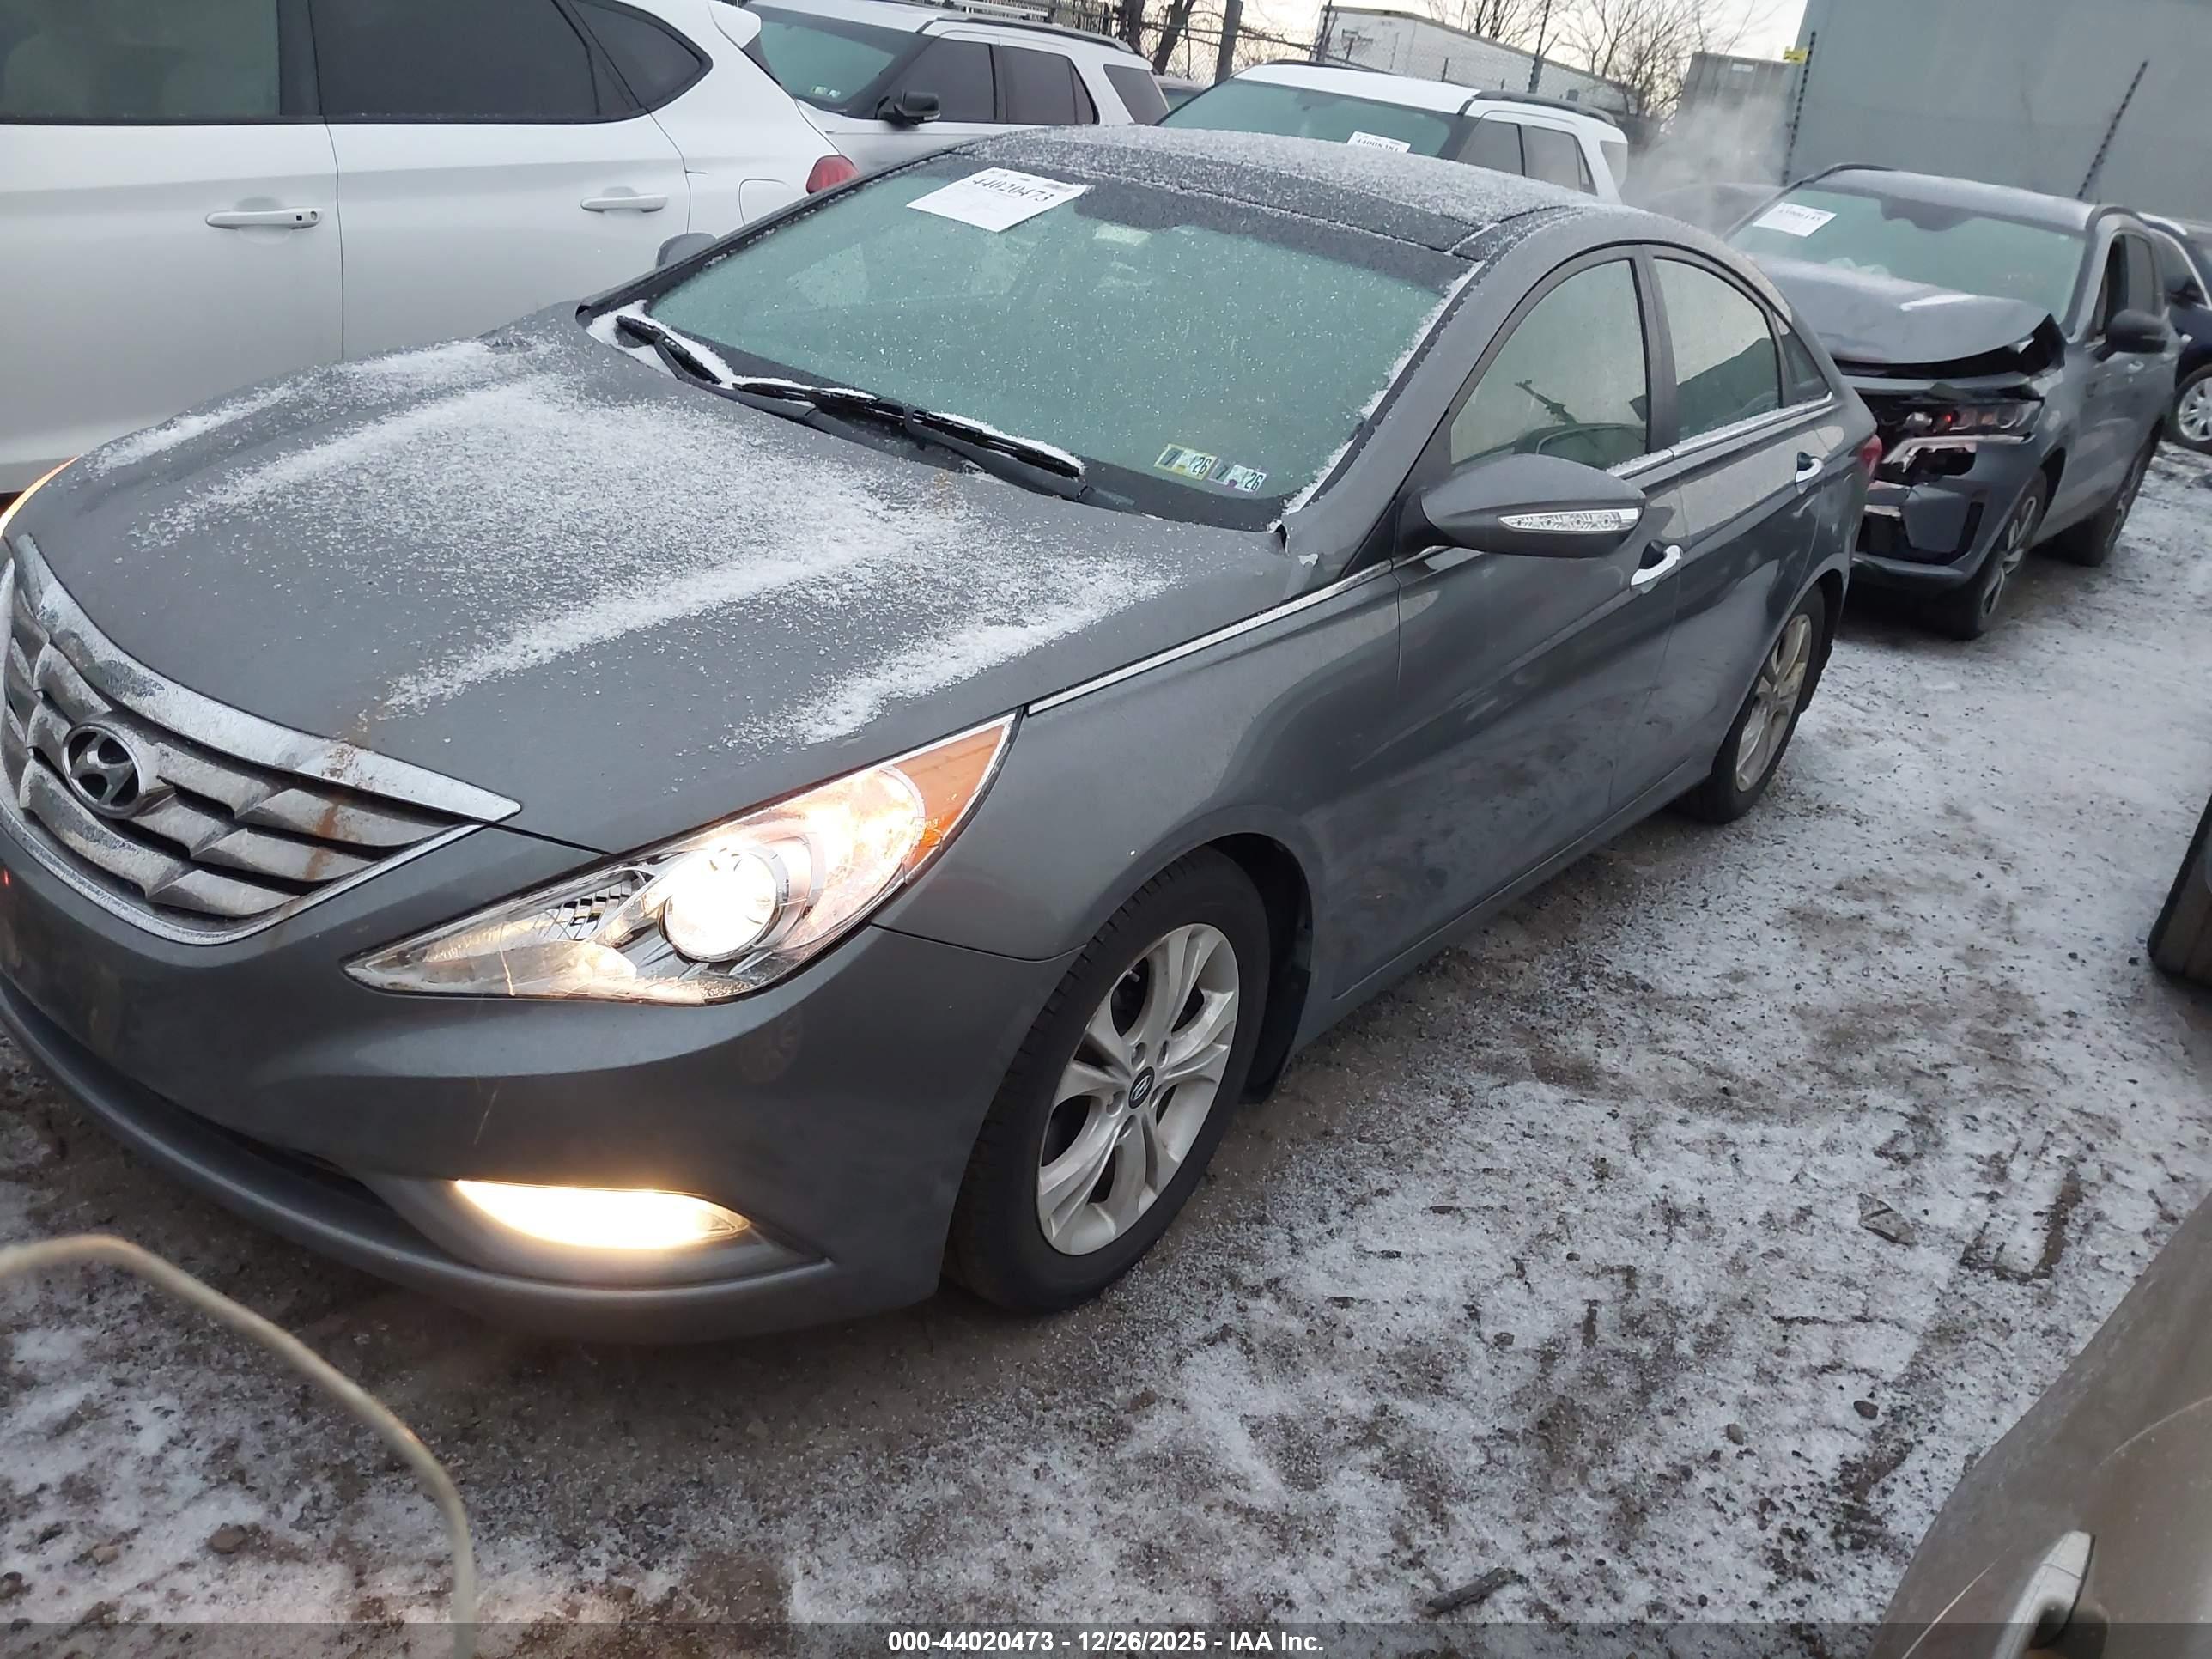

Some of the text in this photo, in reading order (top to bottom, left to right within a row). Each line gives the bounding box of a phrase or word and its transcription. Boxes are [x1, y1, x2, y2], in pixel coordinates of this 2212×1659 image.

[972, 177, 1055, 202] 44020473
[1192, 456, 1212, 475] 26
[1244, 472, 1264, 491] 26
